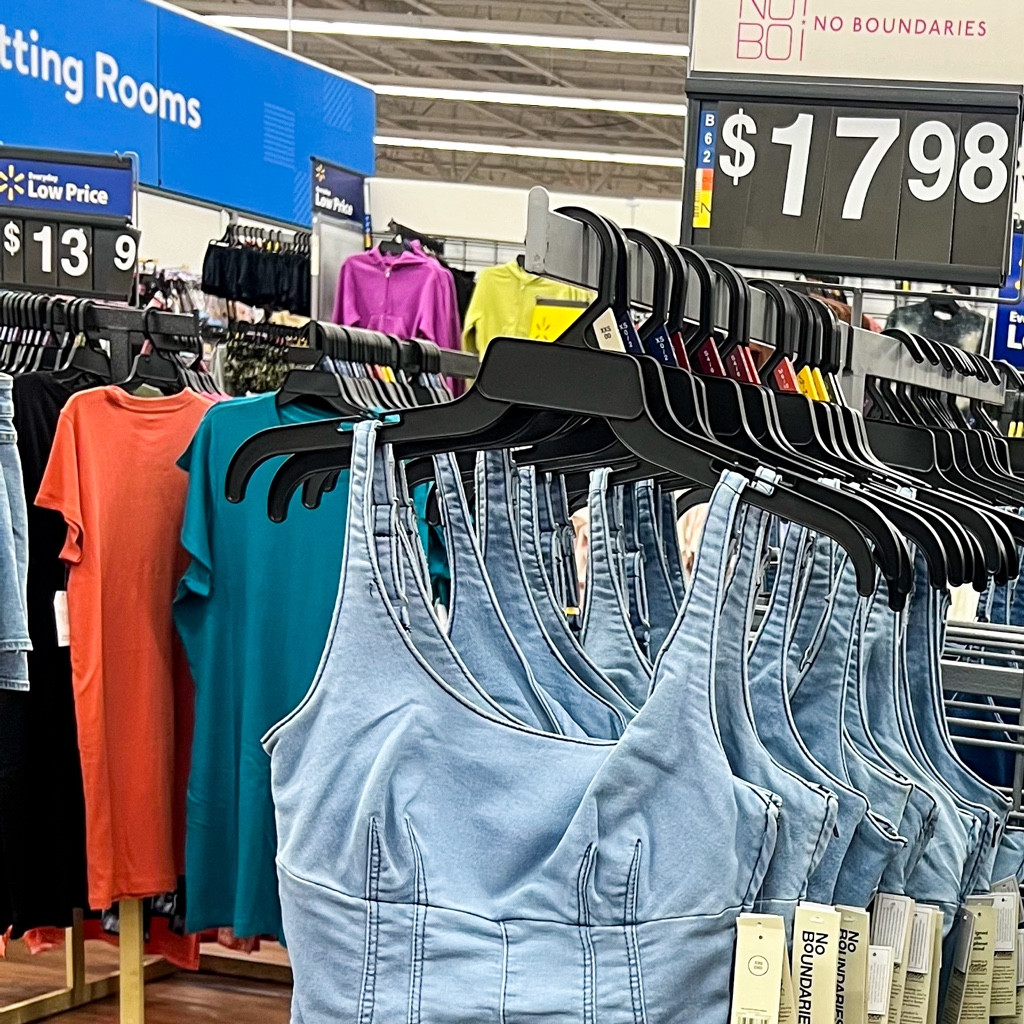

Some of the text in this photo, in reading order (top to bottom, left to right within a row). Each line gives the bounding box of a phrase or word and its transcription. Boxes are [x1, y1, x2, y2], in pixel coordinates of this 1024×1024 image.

[813, 15, 988, 37] NO BOUNDARIES
[95, 50, 202, 130] Rooms
[27, 179, 109, 205] Low Price
[815, 932, 829, 956] NO
[848, 930, 860, 953] NO
